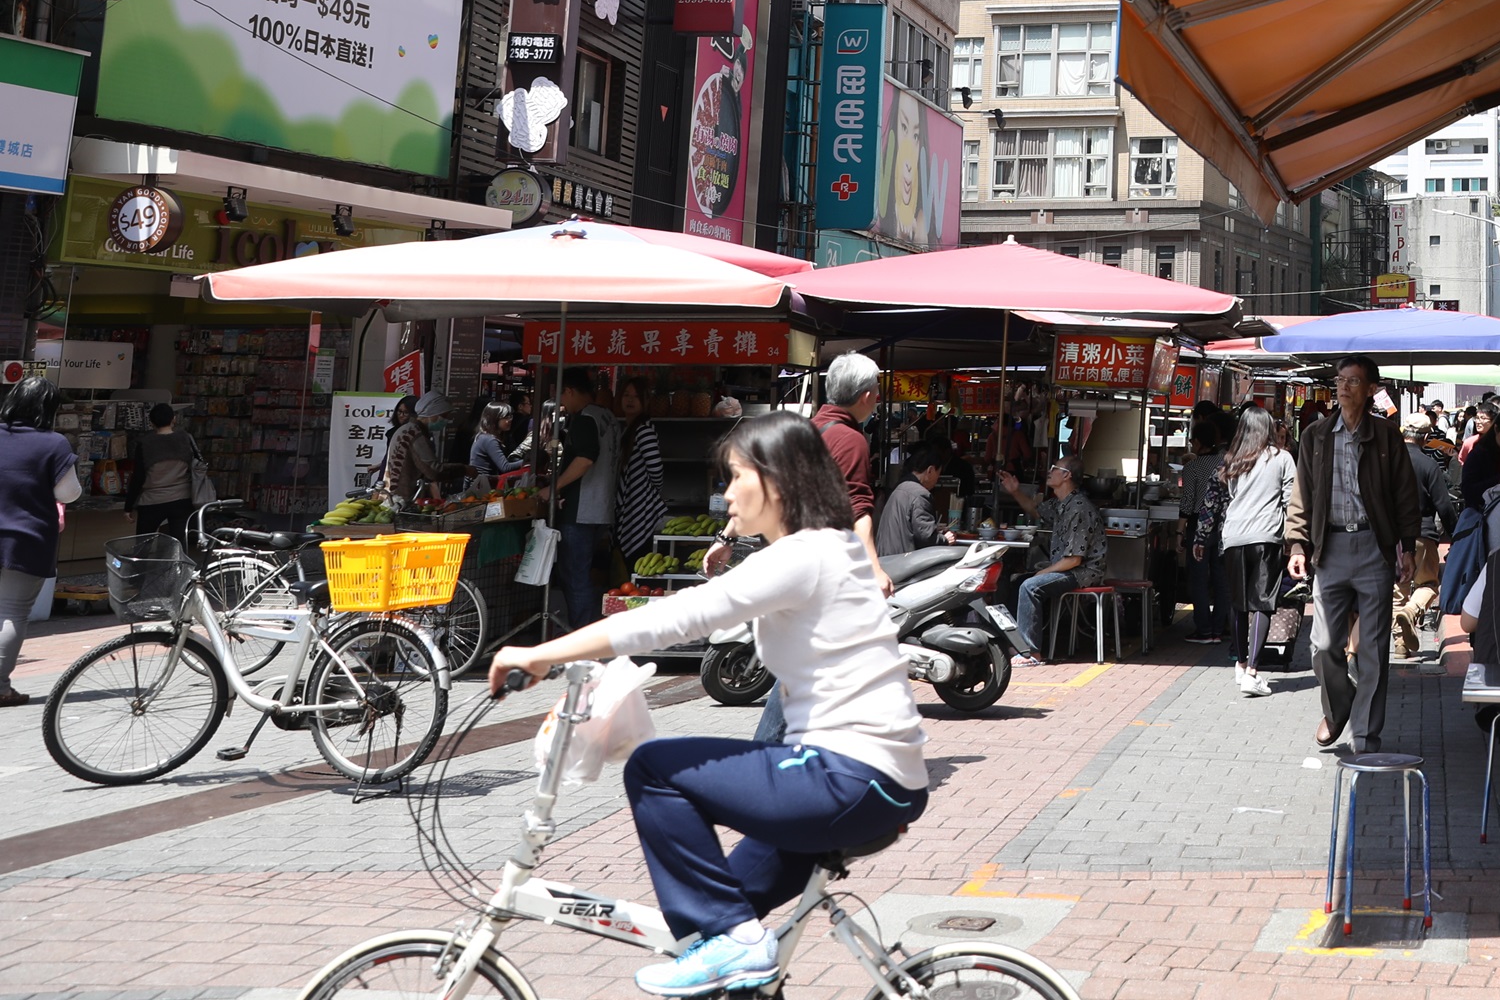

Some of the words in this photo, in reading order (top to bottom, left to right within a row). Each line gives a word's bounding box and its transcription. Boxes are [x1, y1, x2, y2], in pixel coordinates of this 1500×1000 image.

[248, 14, 374, 69] 100%日本直送!
[510, 36, 555, 48] 預約電話
[509, 48, 554, 60] 2585-3777
[118, 191, 133, 205] YAN
[137, 188, 164, 206] GOODS
[119, 205, 157, 232] $49
[152, 211, 168, 241] COLOR
[111, 227, 125, 244] LIFE
[126, 241, 151, 250] YOUR
[172, 244, 194, 260] Life
[767, 347, 780, 357] 34
[1060, 342, 1146, 366] 清粥小菜
[85, 359, 101, 369] Life
[1174, 374, 1193, 399] 餅
[345, 405, 394, 418] icolor
[348, 424, 385, 441] 全店
[559, 903, 615, 918] GEAR
